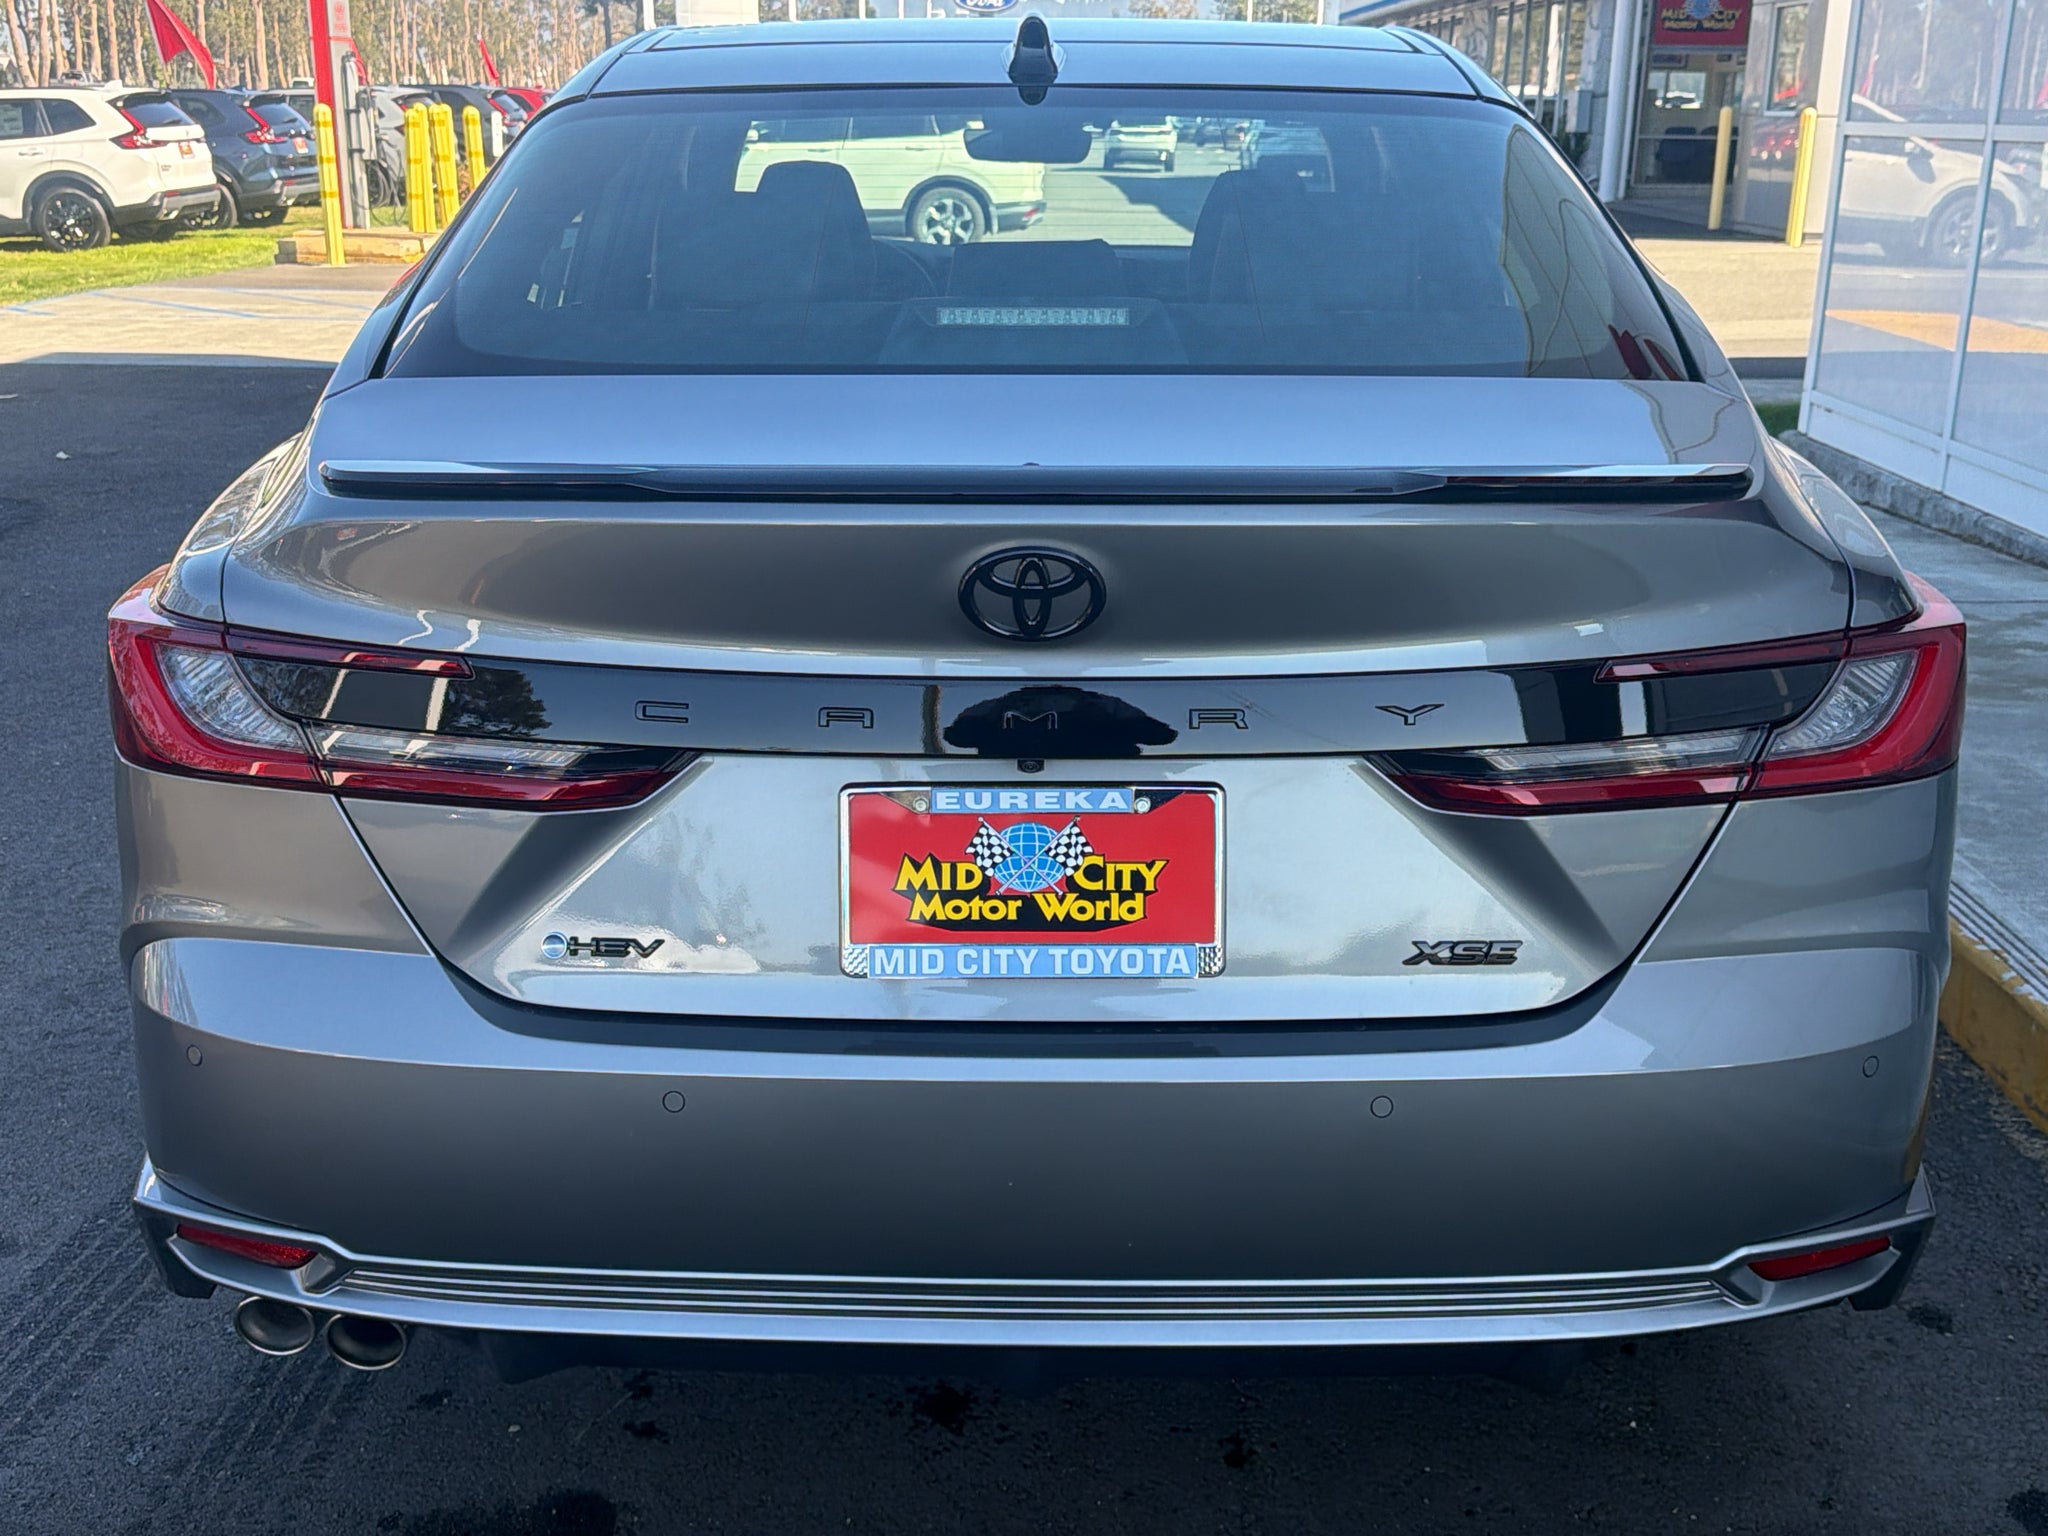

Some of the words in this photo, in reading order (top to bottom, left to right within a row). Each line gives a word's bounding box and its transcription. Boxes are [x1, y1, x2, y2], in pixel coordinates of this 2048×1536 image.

[634, 700, 1445, 730] CAMRY
[935, 790, 1132, 811] EUREKA
[909, 893, 1022, 921] Motor
[1030, 892, 1146, 922] World
[568, 935, 666, 959] HEV
[1402, 939, 1523, 966] XSE
[873, 946, 945, 977] MID
[956, 947, 1043, 977] CITY
[1048, 947, 1192, 975] TOYOTA
